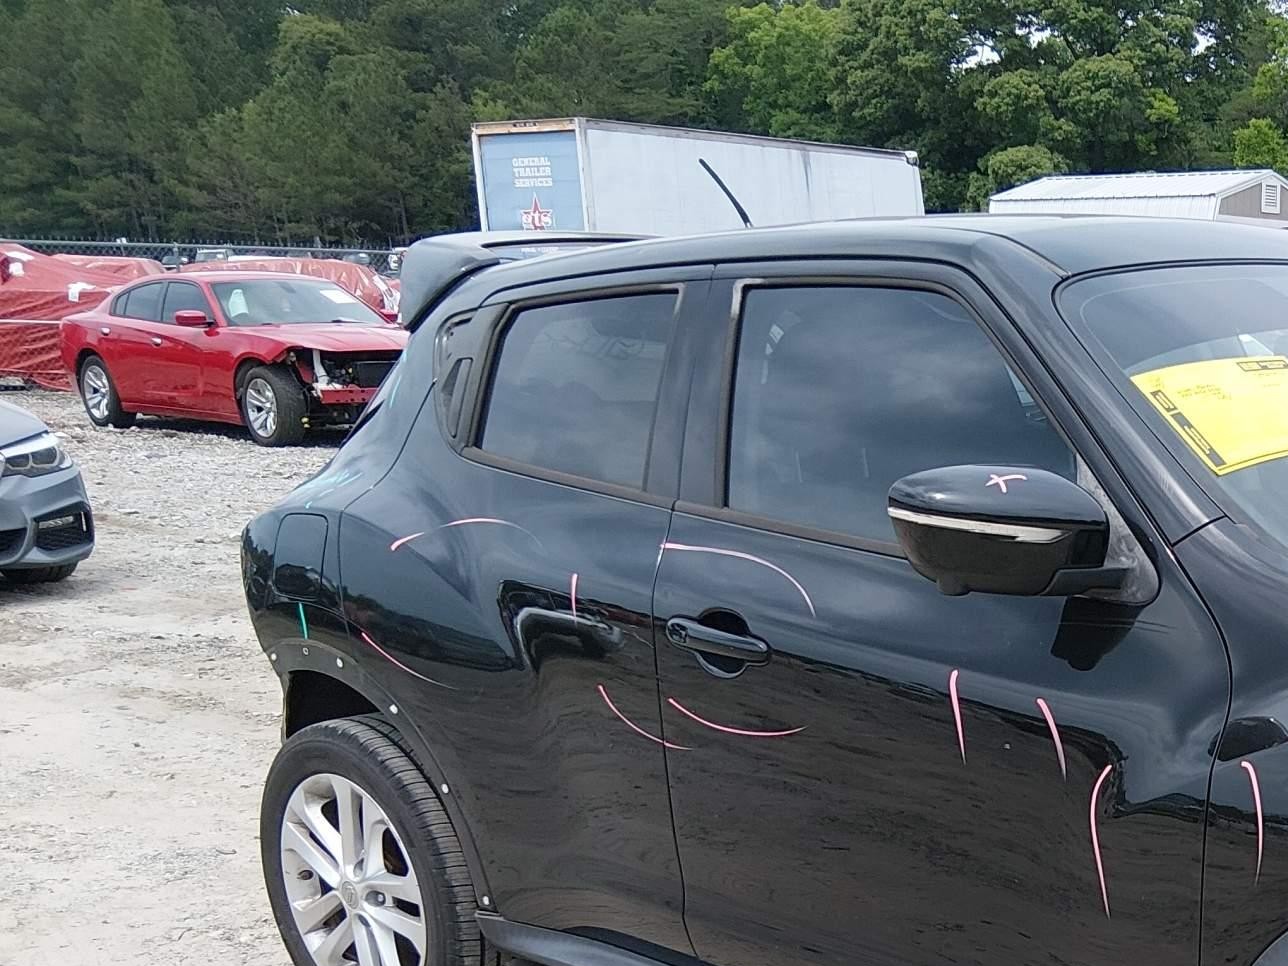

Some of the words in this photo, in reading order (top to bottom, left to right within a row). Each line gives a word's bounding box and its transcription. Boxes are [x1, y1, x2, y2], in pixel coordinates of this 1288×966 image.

[512, 156, 551, 168] GENERAL
[512, 167, 552, 177] TRAILER
[514, 178, 553, 188] SERVICES
